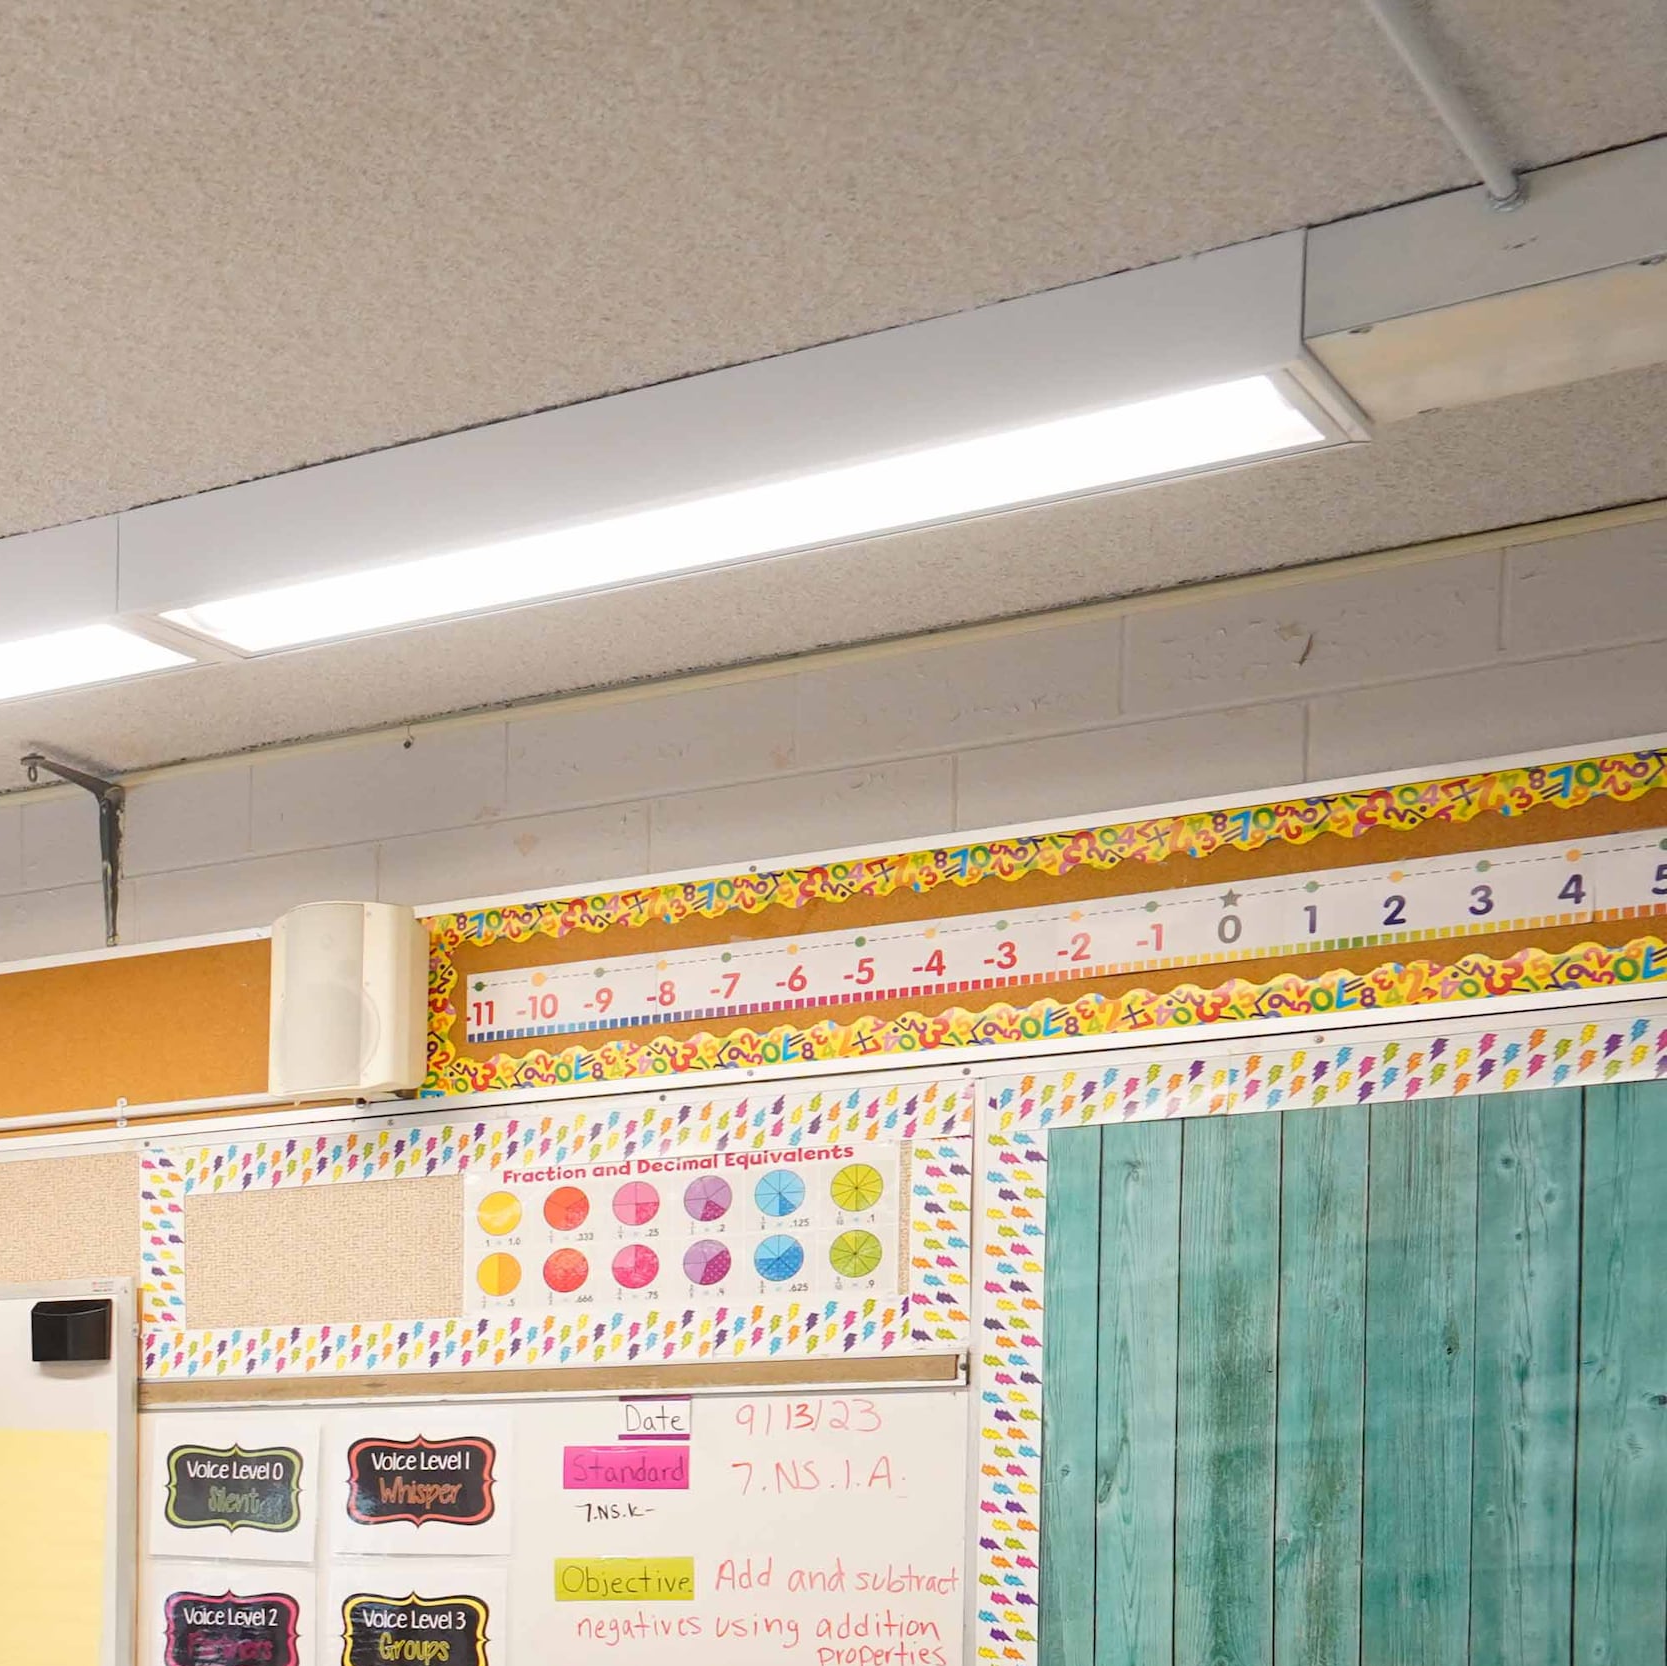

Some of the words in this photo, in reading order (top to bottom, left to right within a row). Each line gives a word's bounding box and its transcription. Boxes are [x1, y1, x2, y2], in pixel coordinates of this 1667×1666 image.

[517, 993, 559, 1020] -10
[583, 987, 613, 1014] -9
[646, 981, 675, 1008] -8
[710, 972, 741, 999] -7
[775, 966, 807, 992] -6
[843, 957, 875, 985] -5
[911, 949, 946, 977] -4
[983, 941, 1017, 969] -3
[1057, 933, 1091, 961] -2
[1136, 924, 1164, 952] -1
[1217, 915, 1243, 944] 0
[1303, 905, 1318, 934] 1
[1383, 895, 1407, 926] 2
[1469, 884, 1494, 915] 3
[1558, 874, 1586, 904] 4
[503, 1166, 586, 1184] Fraction
[593, 1159, 631, 1178] and
[637, 1155, 718, 1174] Decimal
[724, 1146, 855, 1169] Equivalents
[625, 1404, 685, 1432] Date
[187, 1461, 229, 1479] Voice
[232, 1461, 269, 1479] Level
[273, 1462, 284, 1479] 0
[371, 1452, 416, 1470] Voice
[420, 1452, 462, 1470] Level
[573, 1454, 685, 1484] Standard
[379, 1476, 463, 1509] Whisper
[715, 1557, 773, 1592] Add
[787, 1557, 847, 1593] and
[854, 1564, 960, 1596] subtract
[183, 1608, 225, 1626] Voice
[227, 1608, 266, 1626] Level
[268, 1608, 279, 1627] 2
[363, 1609, 408, 1628] Voice
[411, 1610, 453, 1629] Level
[456, 1611, 467, 1629] 3
[577, 1611, 703, 1647] negatives
[715, 1612, 801, 1650] using
[815, 1609, 941, 1642] addition
[379, 1632, 450, 1666] Groups
